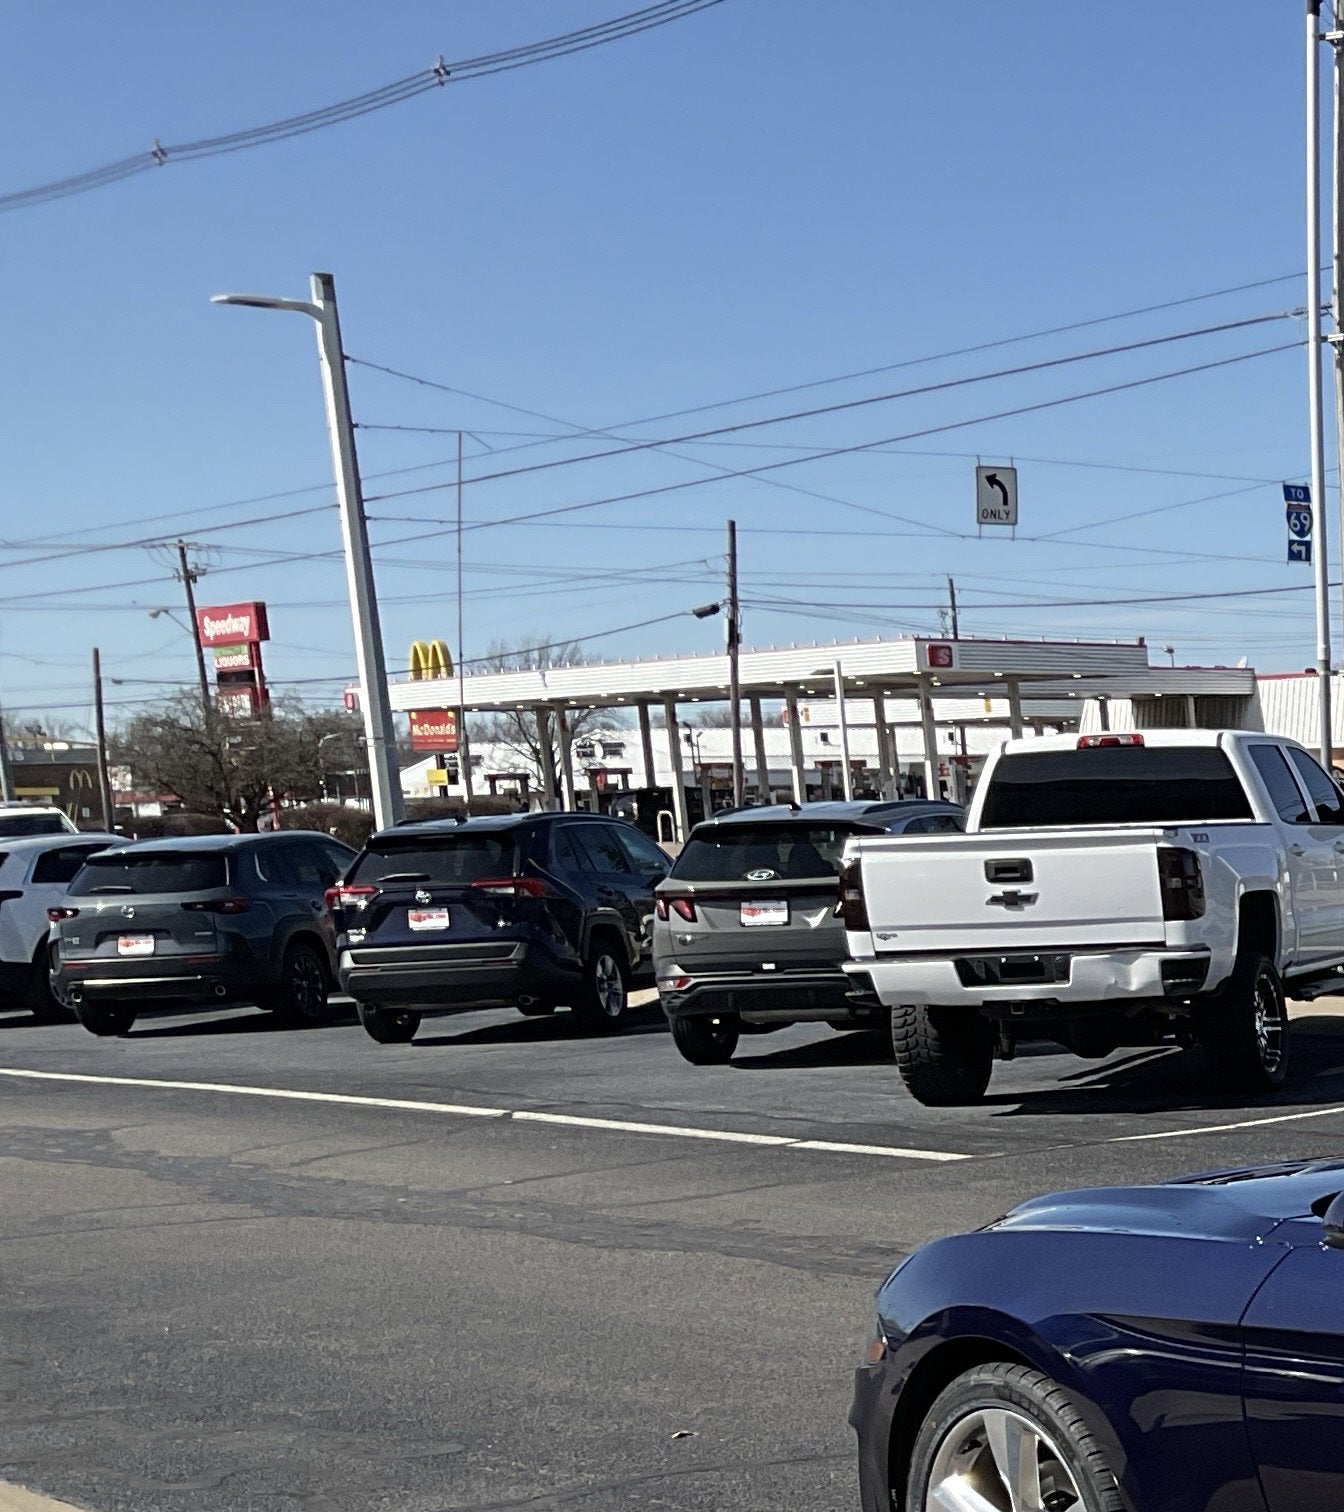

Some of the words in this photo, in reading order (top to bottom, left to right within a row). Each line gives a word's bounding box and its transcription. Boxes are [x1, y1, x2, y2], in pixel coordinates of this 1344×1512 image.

[1290, 488, 1304, 499] TO
[981, 508, 1011, 521] ONLY
[1289, 512, 1311, 532] 69
[203, 613, 250, 641] Speedway
[215, 654, 250, 668] LIQUORS
